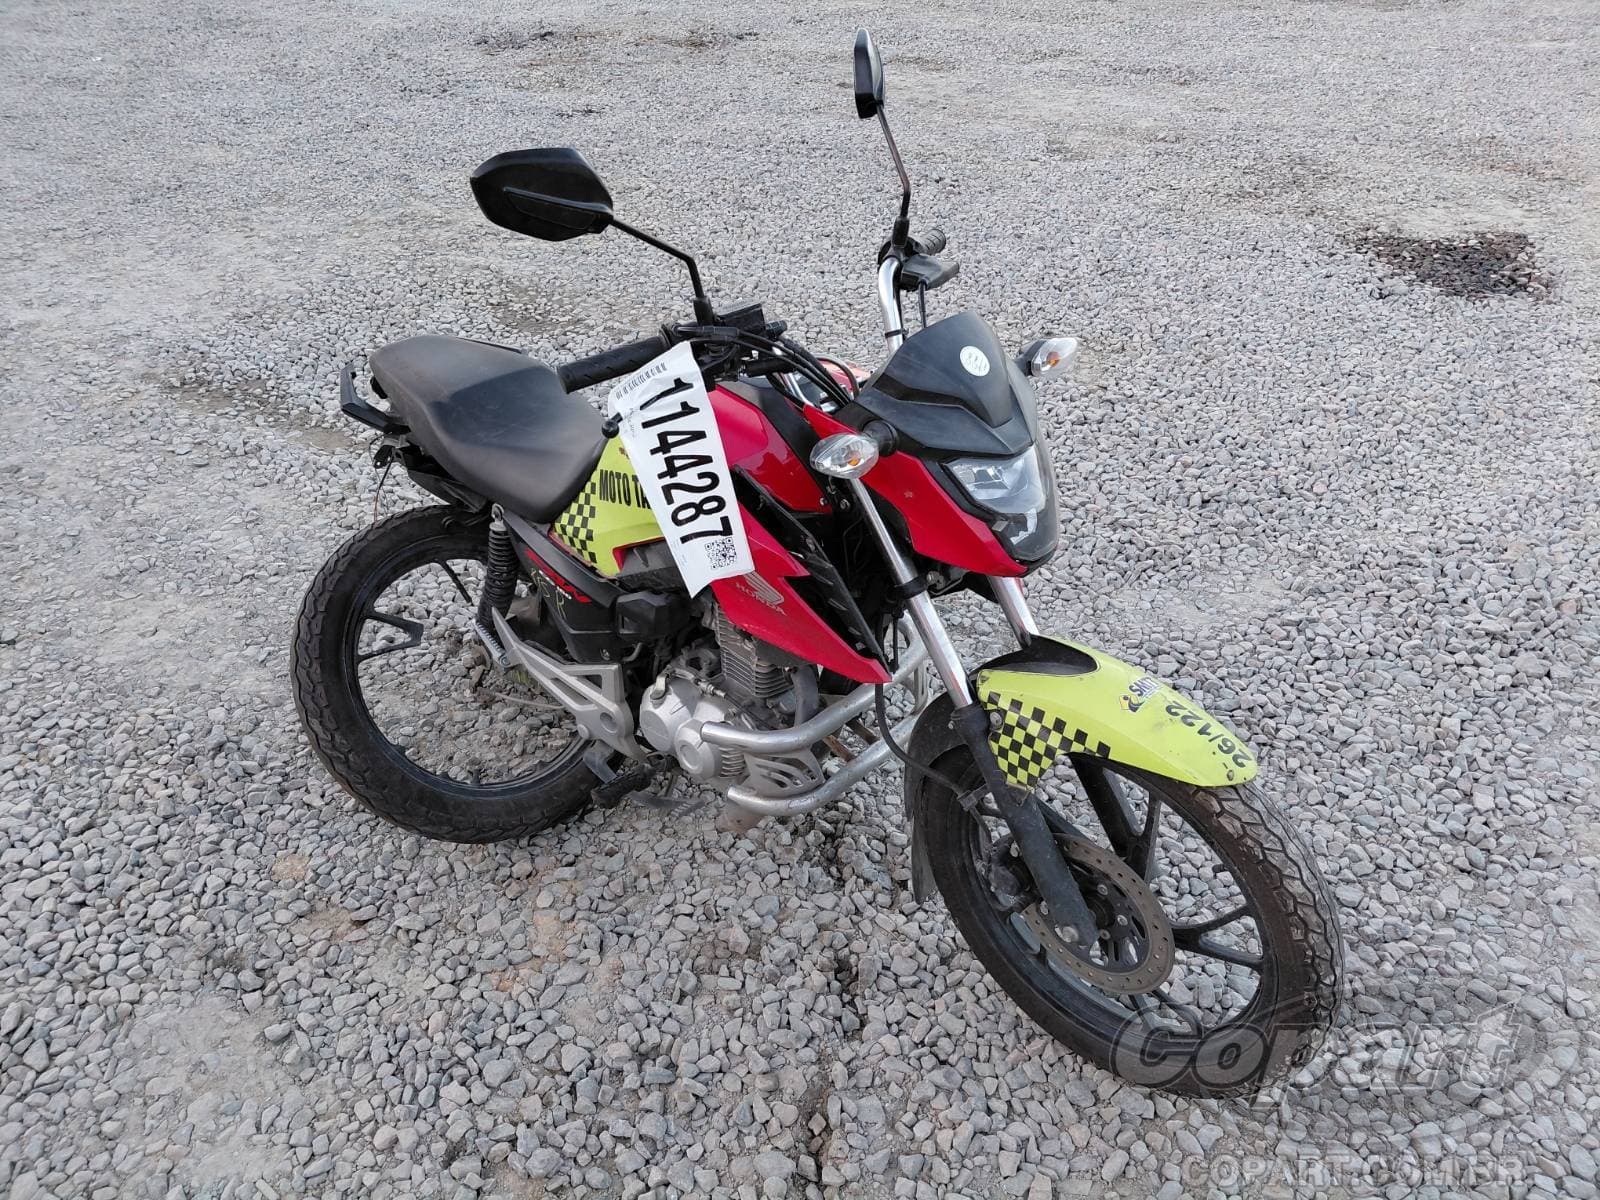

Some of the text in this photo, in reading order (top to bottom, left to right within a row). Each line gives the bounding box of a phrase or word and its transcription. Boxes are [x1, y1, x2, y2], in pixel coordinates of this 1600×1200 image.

[640, 377, 733, 544] 1144287
[600, 469, 651, 510] MOTO TA
[735, 582, 787, 616] HONDA
[1165, 700, 1252, 768] 26/122
